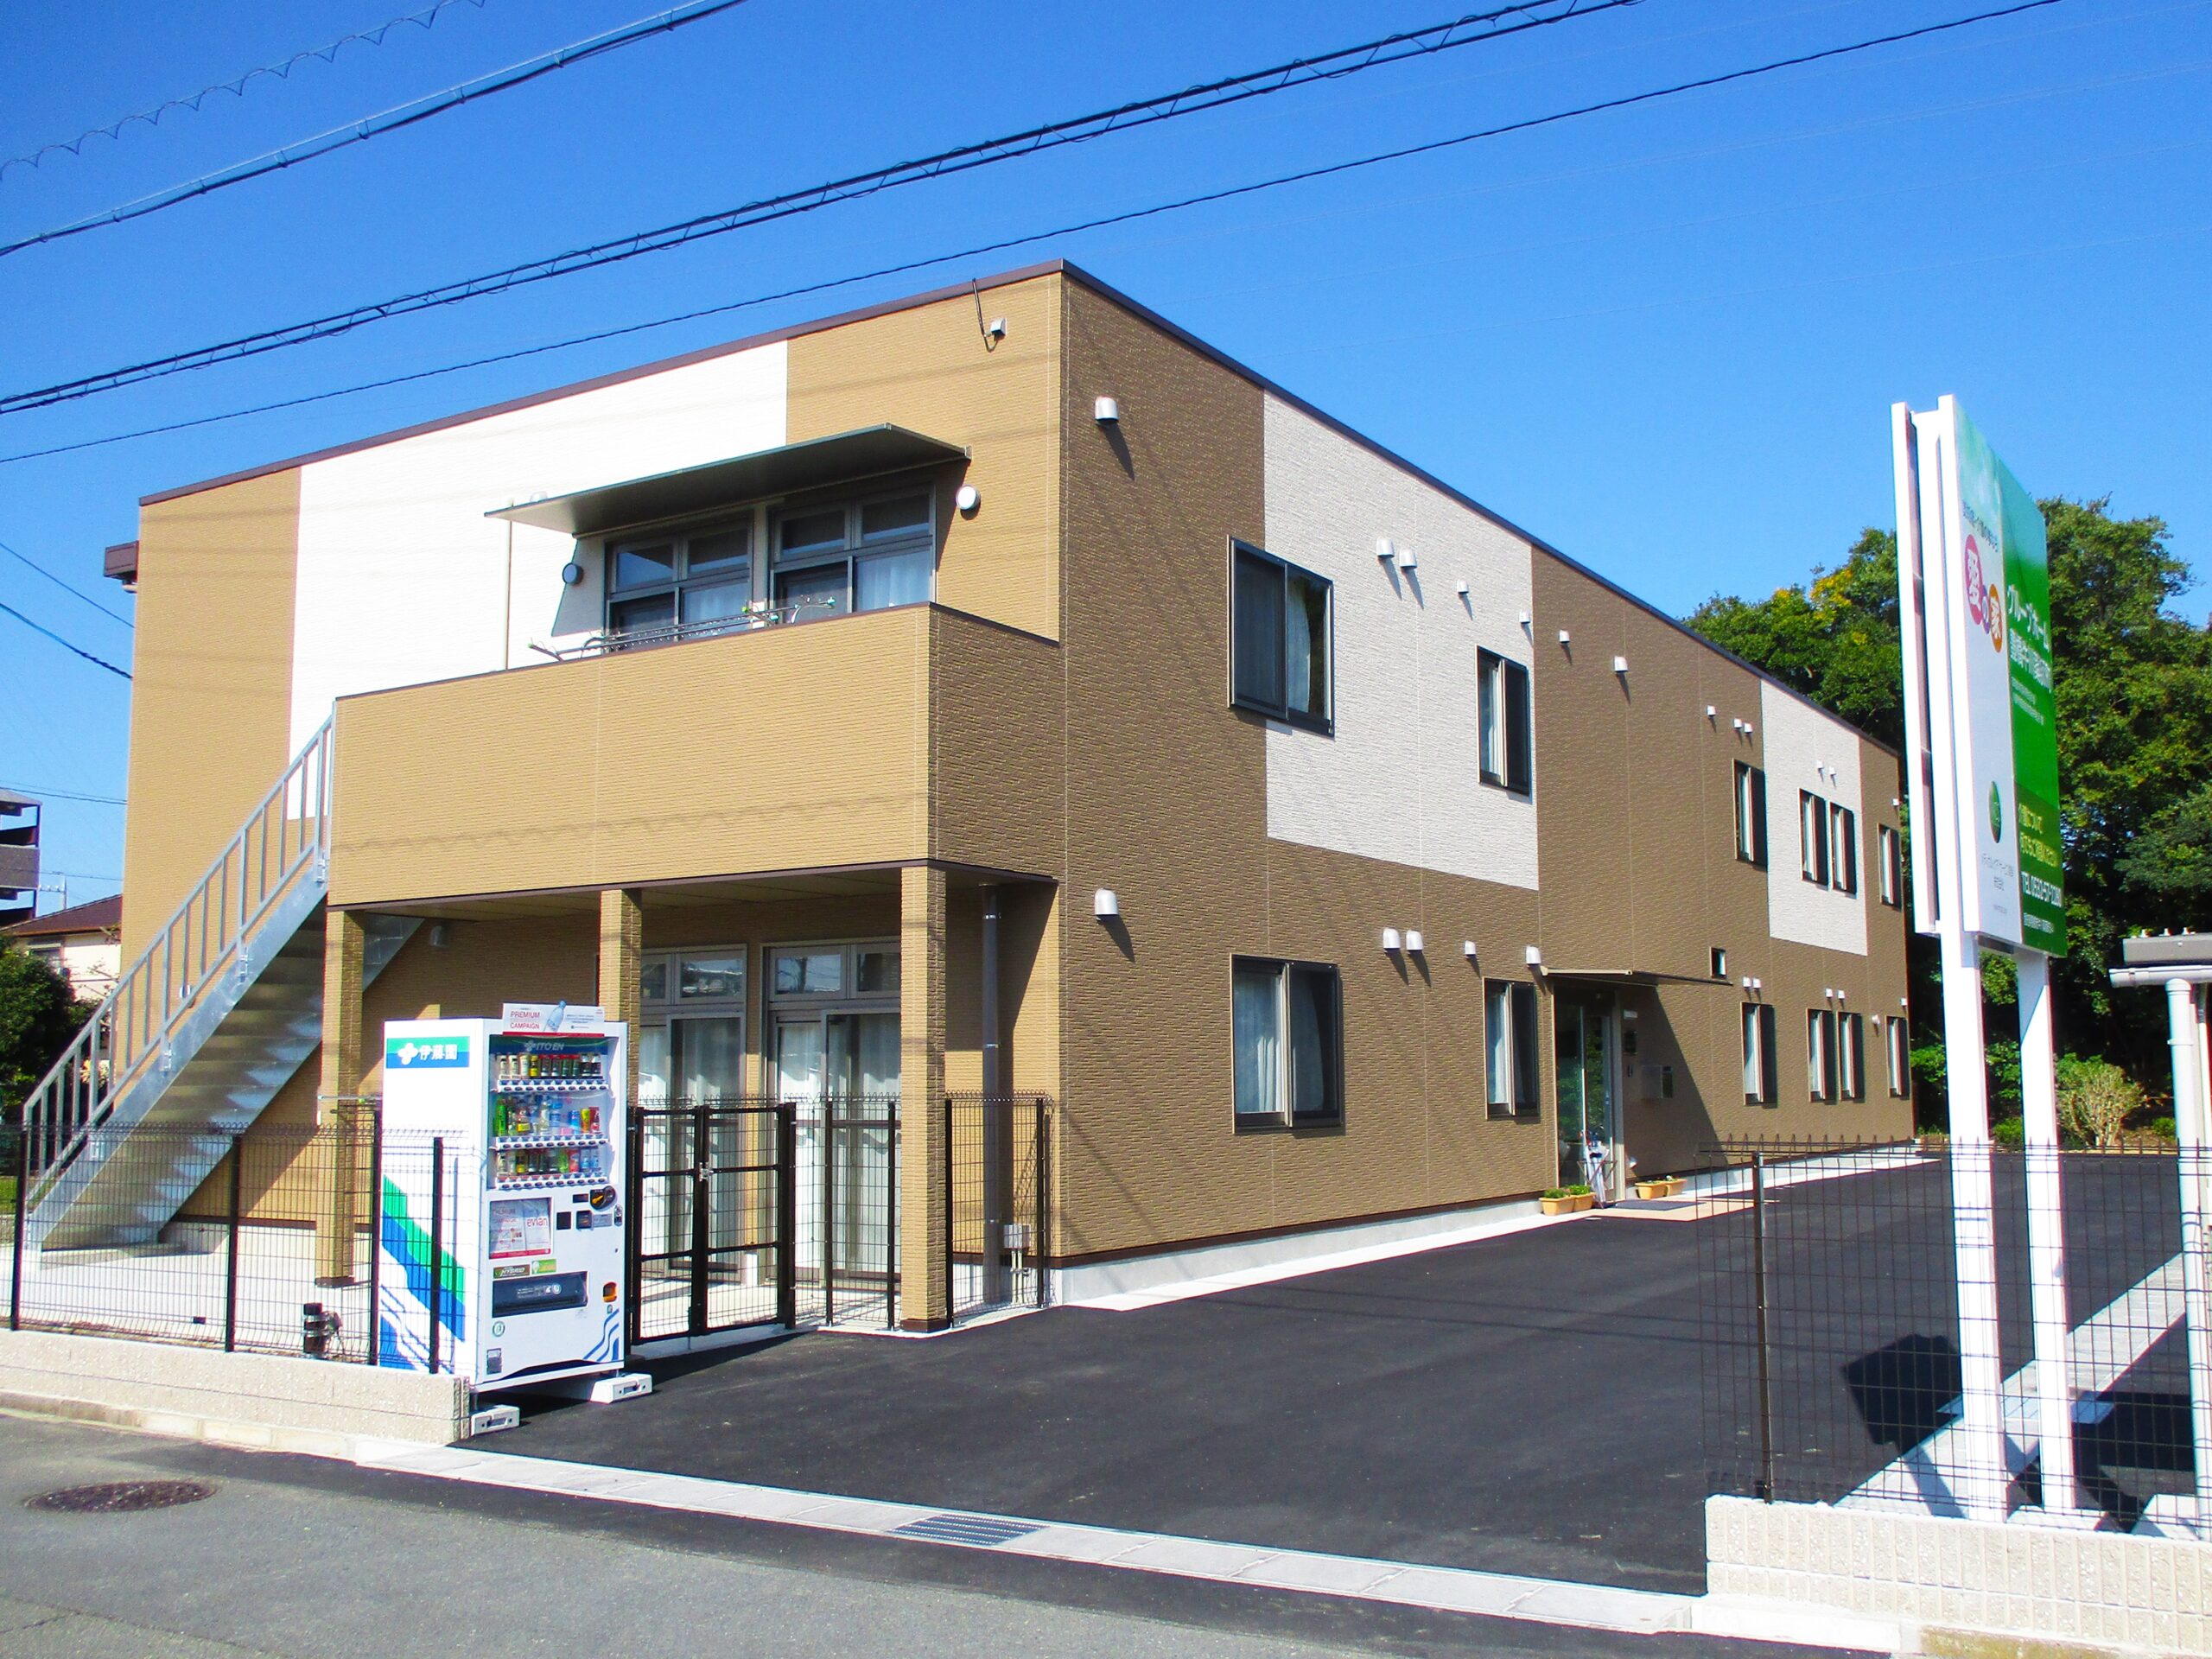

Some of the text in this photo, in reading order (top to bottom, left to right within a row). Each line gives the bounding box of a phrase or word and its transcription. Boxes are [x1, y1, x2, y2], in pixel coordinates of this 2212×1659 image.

[536, 1042, 565, 1052] ITO EN
[419, 1044, 458, 1061] 伊藤園
[526, 1217, 548, 1226] evian
